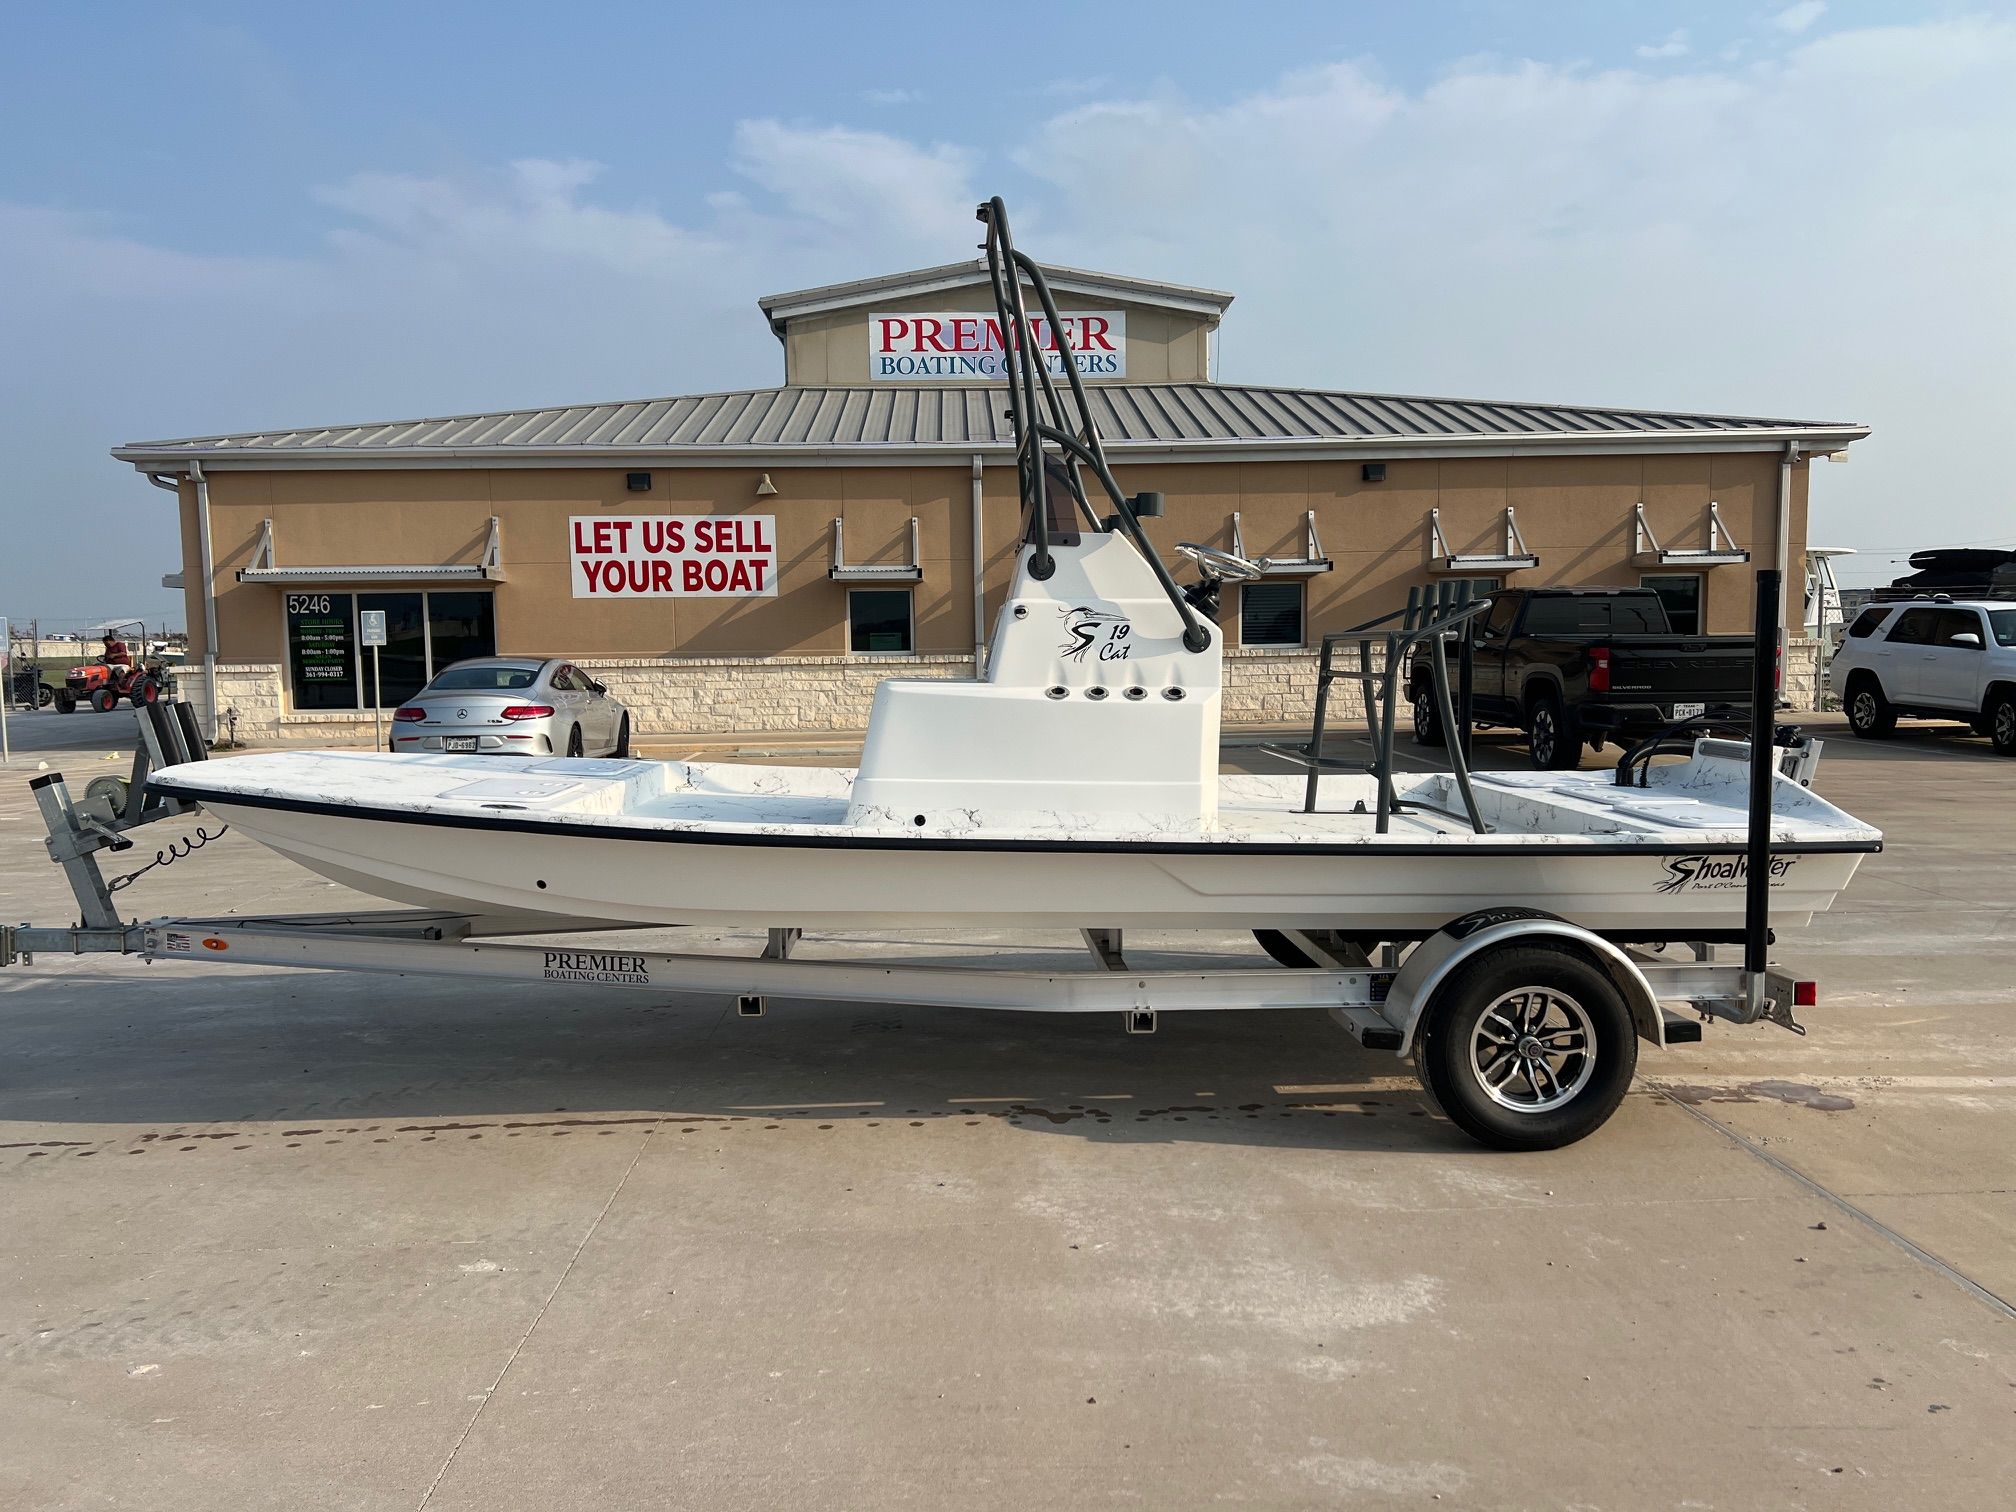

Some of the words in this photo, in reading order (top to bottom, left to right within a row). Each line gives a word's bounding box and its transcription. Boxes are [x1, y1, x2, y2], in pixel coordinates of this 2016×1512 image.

[878, 317, 1116, 353] PREMIER
[880, 356, 995, 375] BOATING
[1001, 354, 1117, 374] NTERS
[574, 521, 633, 554] LET
[642, 520, 686, 554] US
[694, 520, 772, 553] SELL
[580, 560, 673, 593] YOUR
[682, 559, 769, 592] BOAT
[289, 595, 331, 614] 5246
[1109, 624, 1131, 640] 19
[1099, 642, 1132, 661] Cat
[1621, 658, 1754, 669] CHEVROLE
[1657, 854, 1796, 893] Shoalter
[543, 952, 649, 973] PREMIER
[543, 969, 595, 981] BOATING
[596, 972, 649, 984] CENTERS
